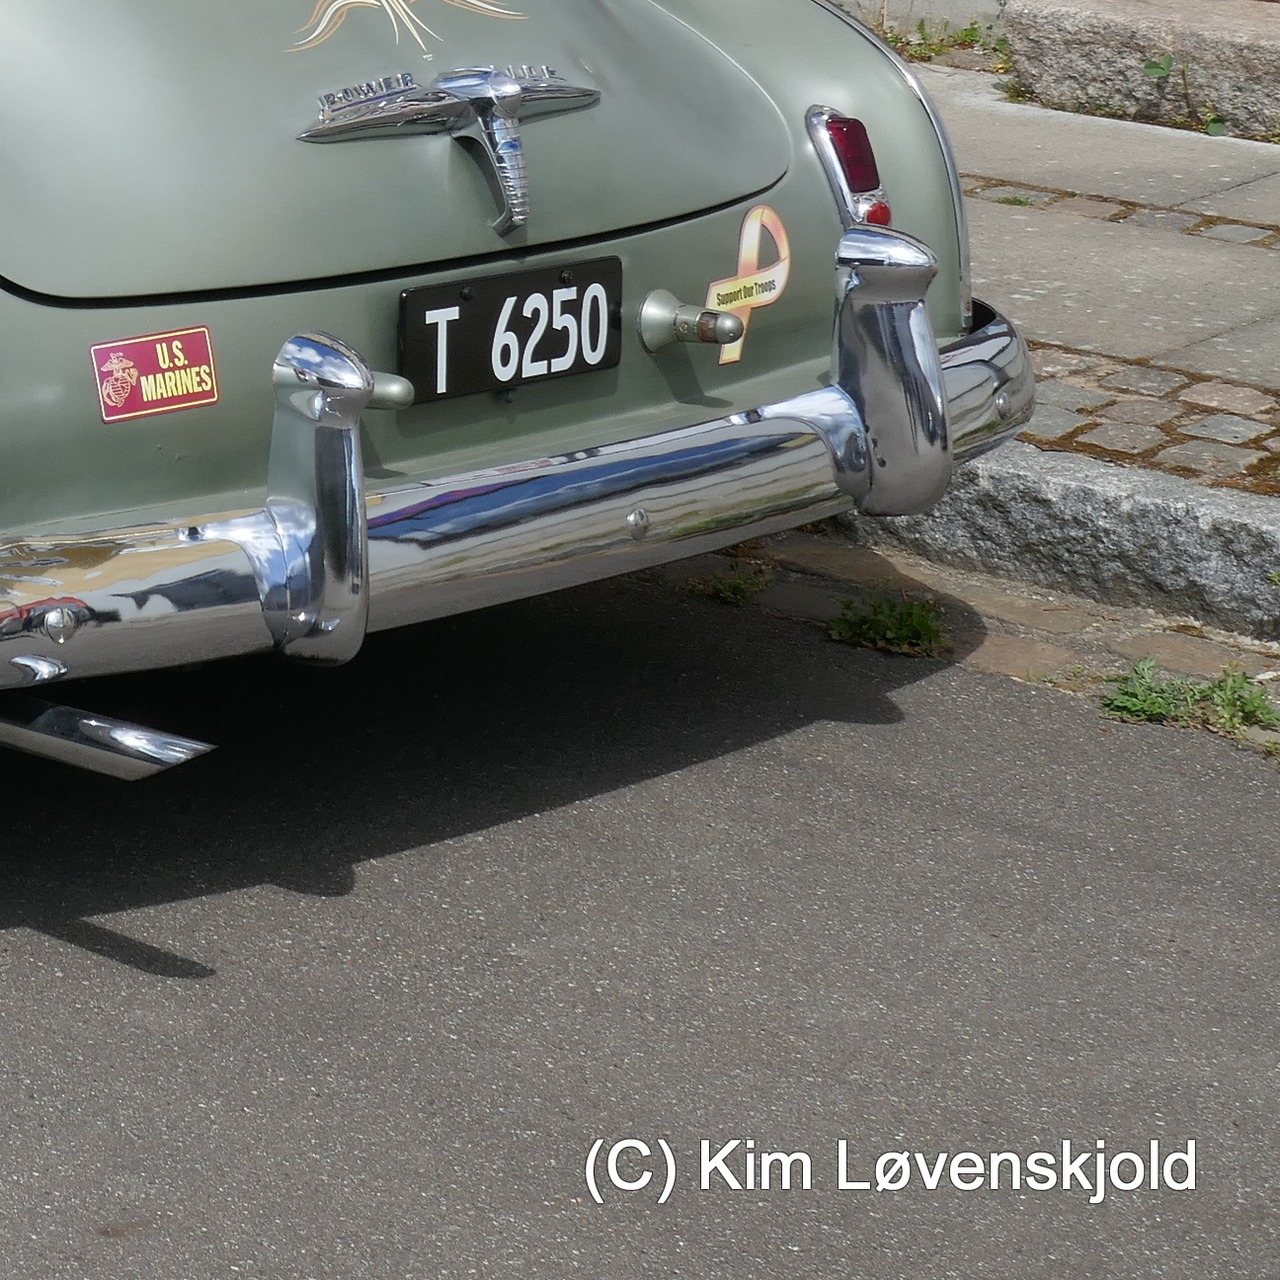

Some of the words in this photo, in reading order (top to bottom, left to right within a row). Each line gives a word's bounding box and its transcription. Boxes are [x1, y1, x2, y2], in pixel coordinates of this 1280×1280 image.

[716, 287, 743, 306] Support
[742, 284, 754, 299] Our
[754, 279, 776, 296] Troops
[155, 340, 189, 369] U.S.
[425, 307, 460, 394] T
[490, 282, 608, 383] 6250
[140, 364, 212, 402] MARINES
